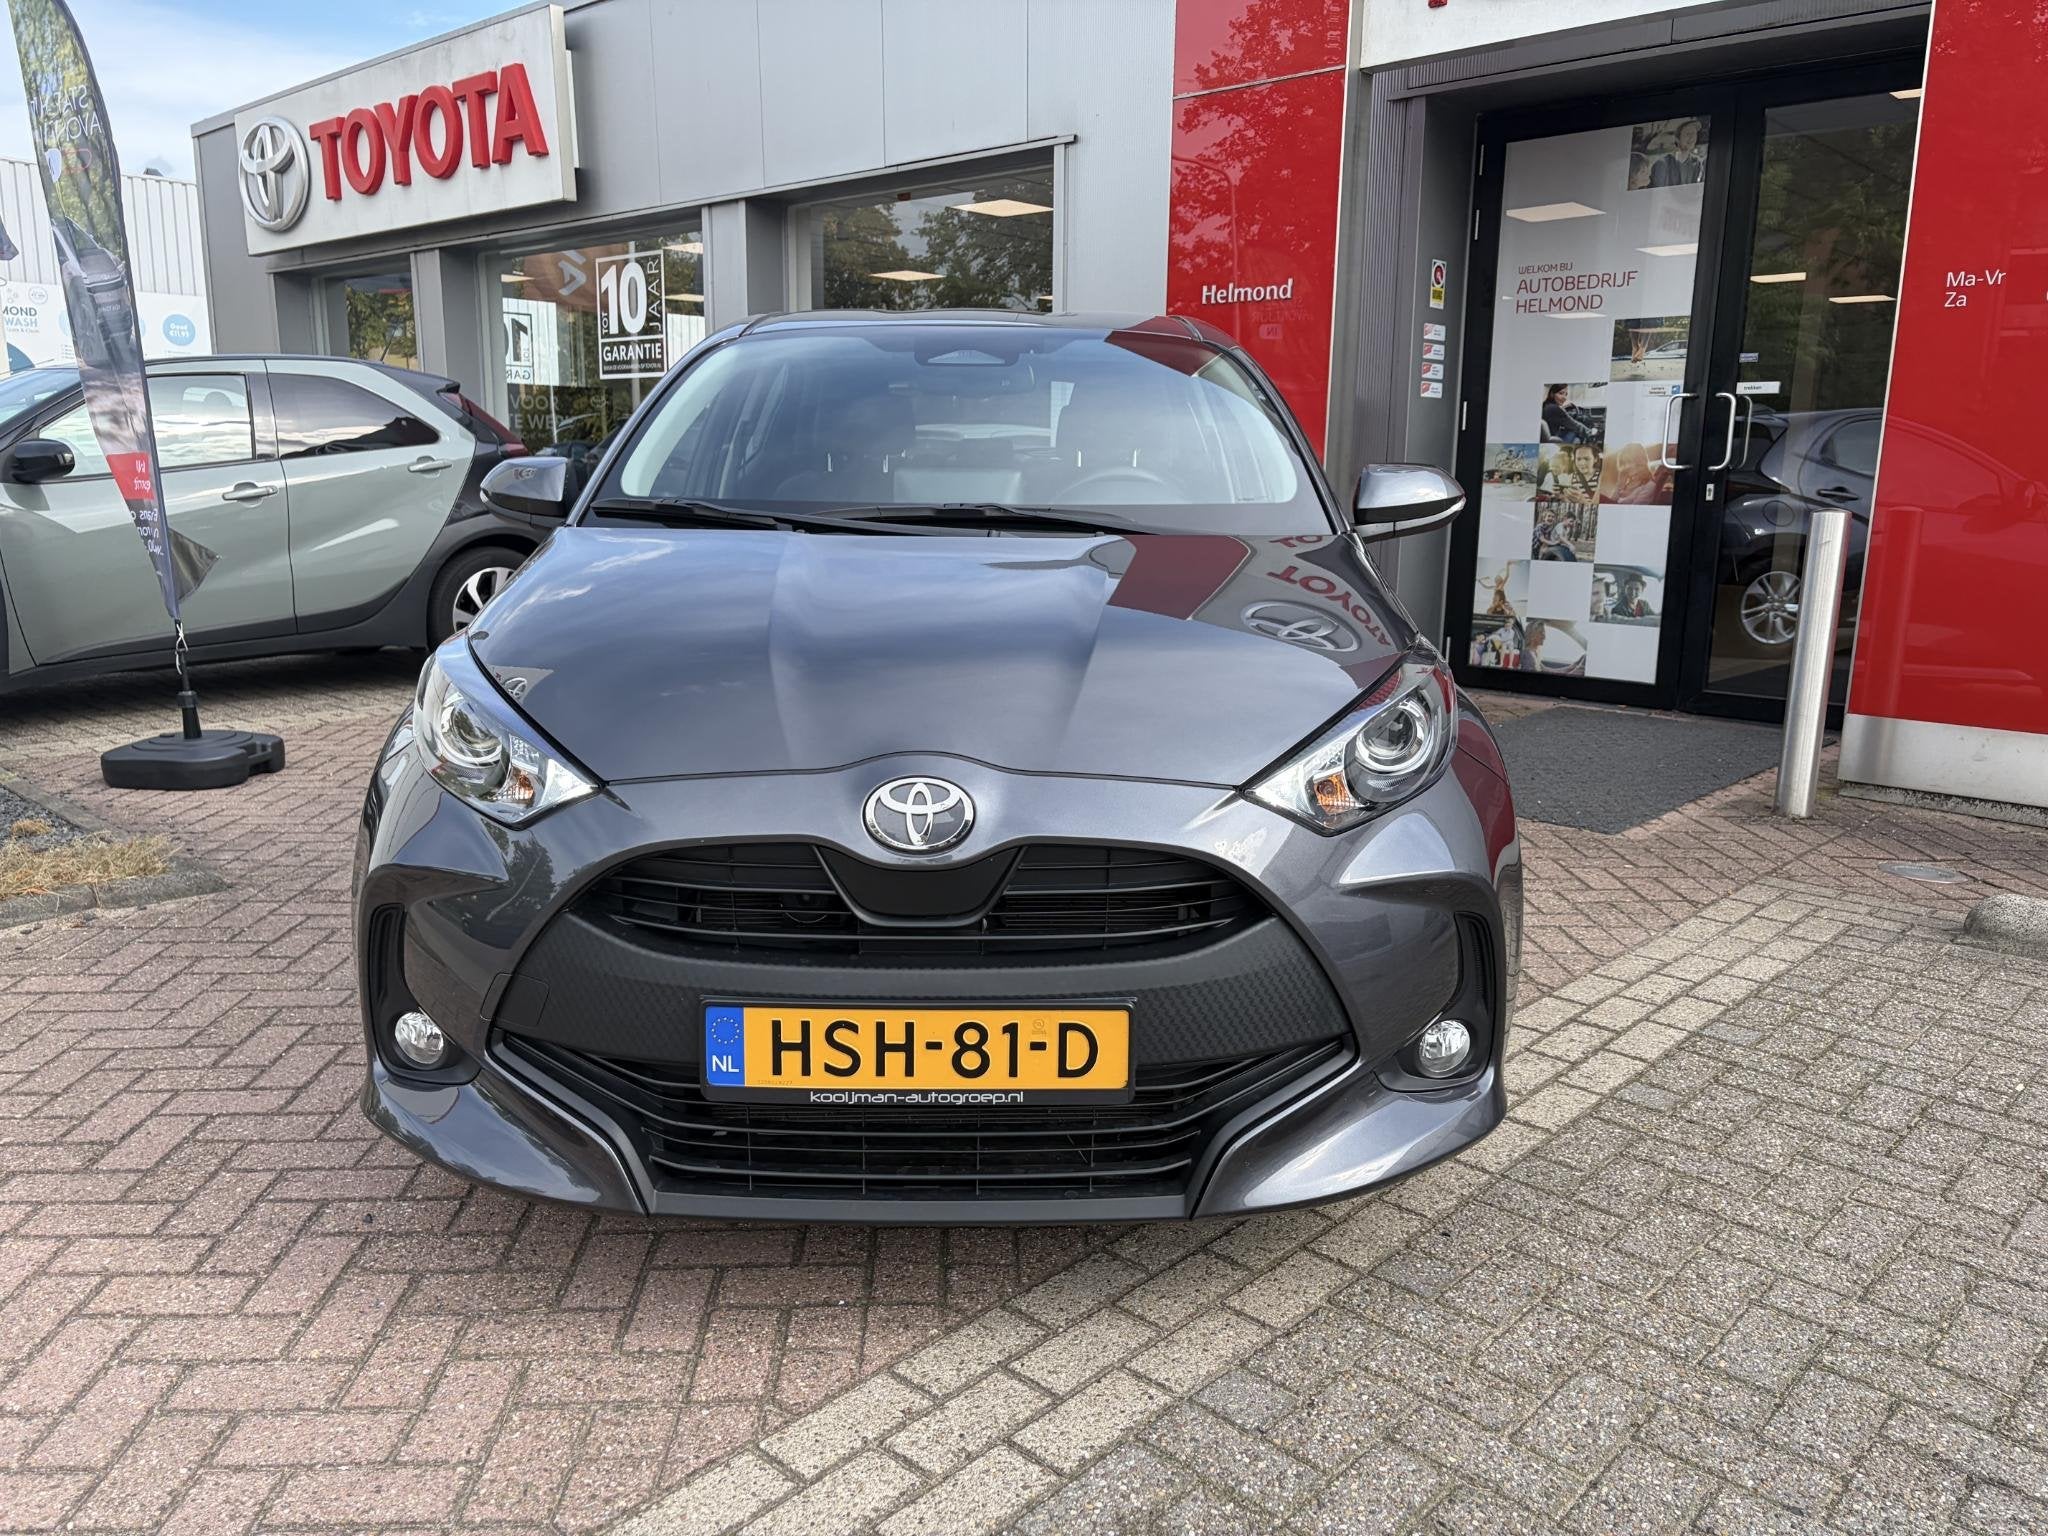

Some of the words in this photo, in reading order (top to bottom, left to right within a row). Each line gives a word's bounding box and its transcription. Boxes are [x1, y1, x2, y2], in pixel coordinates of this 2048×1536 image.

[309, 63, 549, 201] TOYOTA
[1518, 264, 1558, 275] WELKOM
[1559, 261, 1574, 272] BIJ
[1516, 270, 1639, 295] AUTOBEDRIJF
[1946, 269, 2007, 288] Ma-Vr
[600, 262, 648, 335] 10
[647, 258, 661, 332] JAAR
[1201, 277, 1294, 305] Helmond
[1944, 291, 1968, 308] Za
[1515, 294, 1604, 314] HELMOND
[5, 317, 38, 328] WASH
[603, 343, 662, 362] GARANTIE
[711, 1055, 740, 1073] NL
[771, 1019, 1099, 1079] HSH-81-D
[809, 1091, 1024, 1105] kooijman-autogroep.nl
